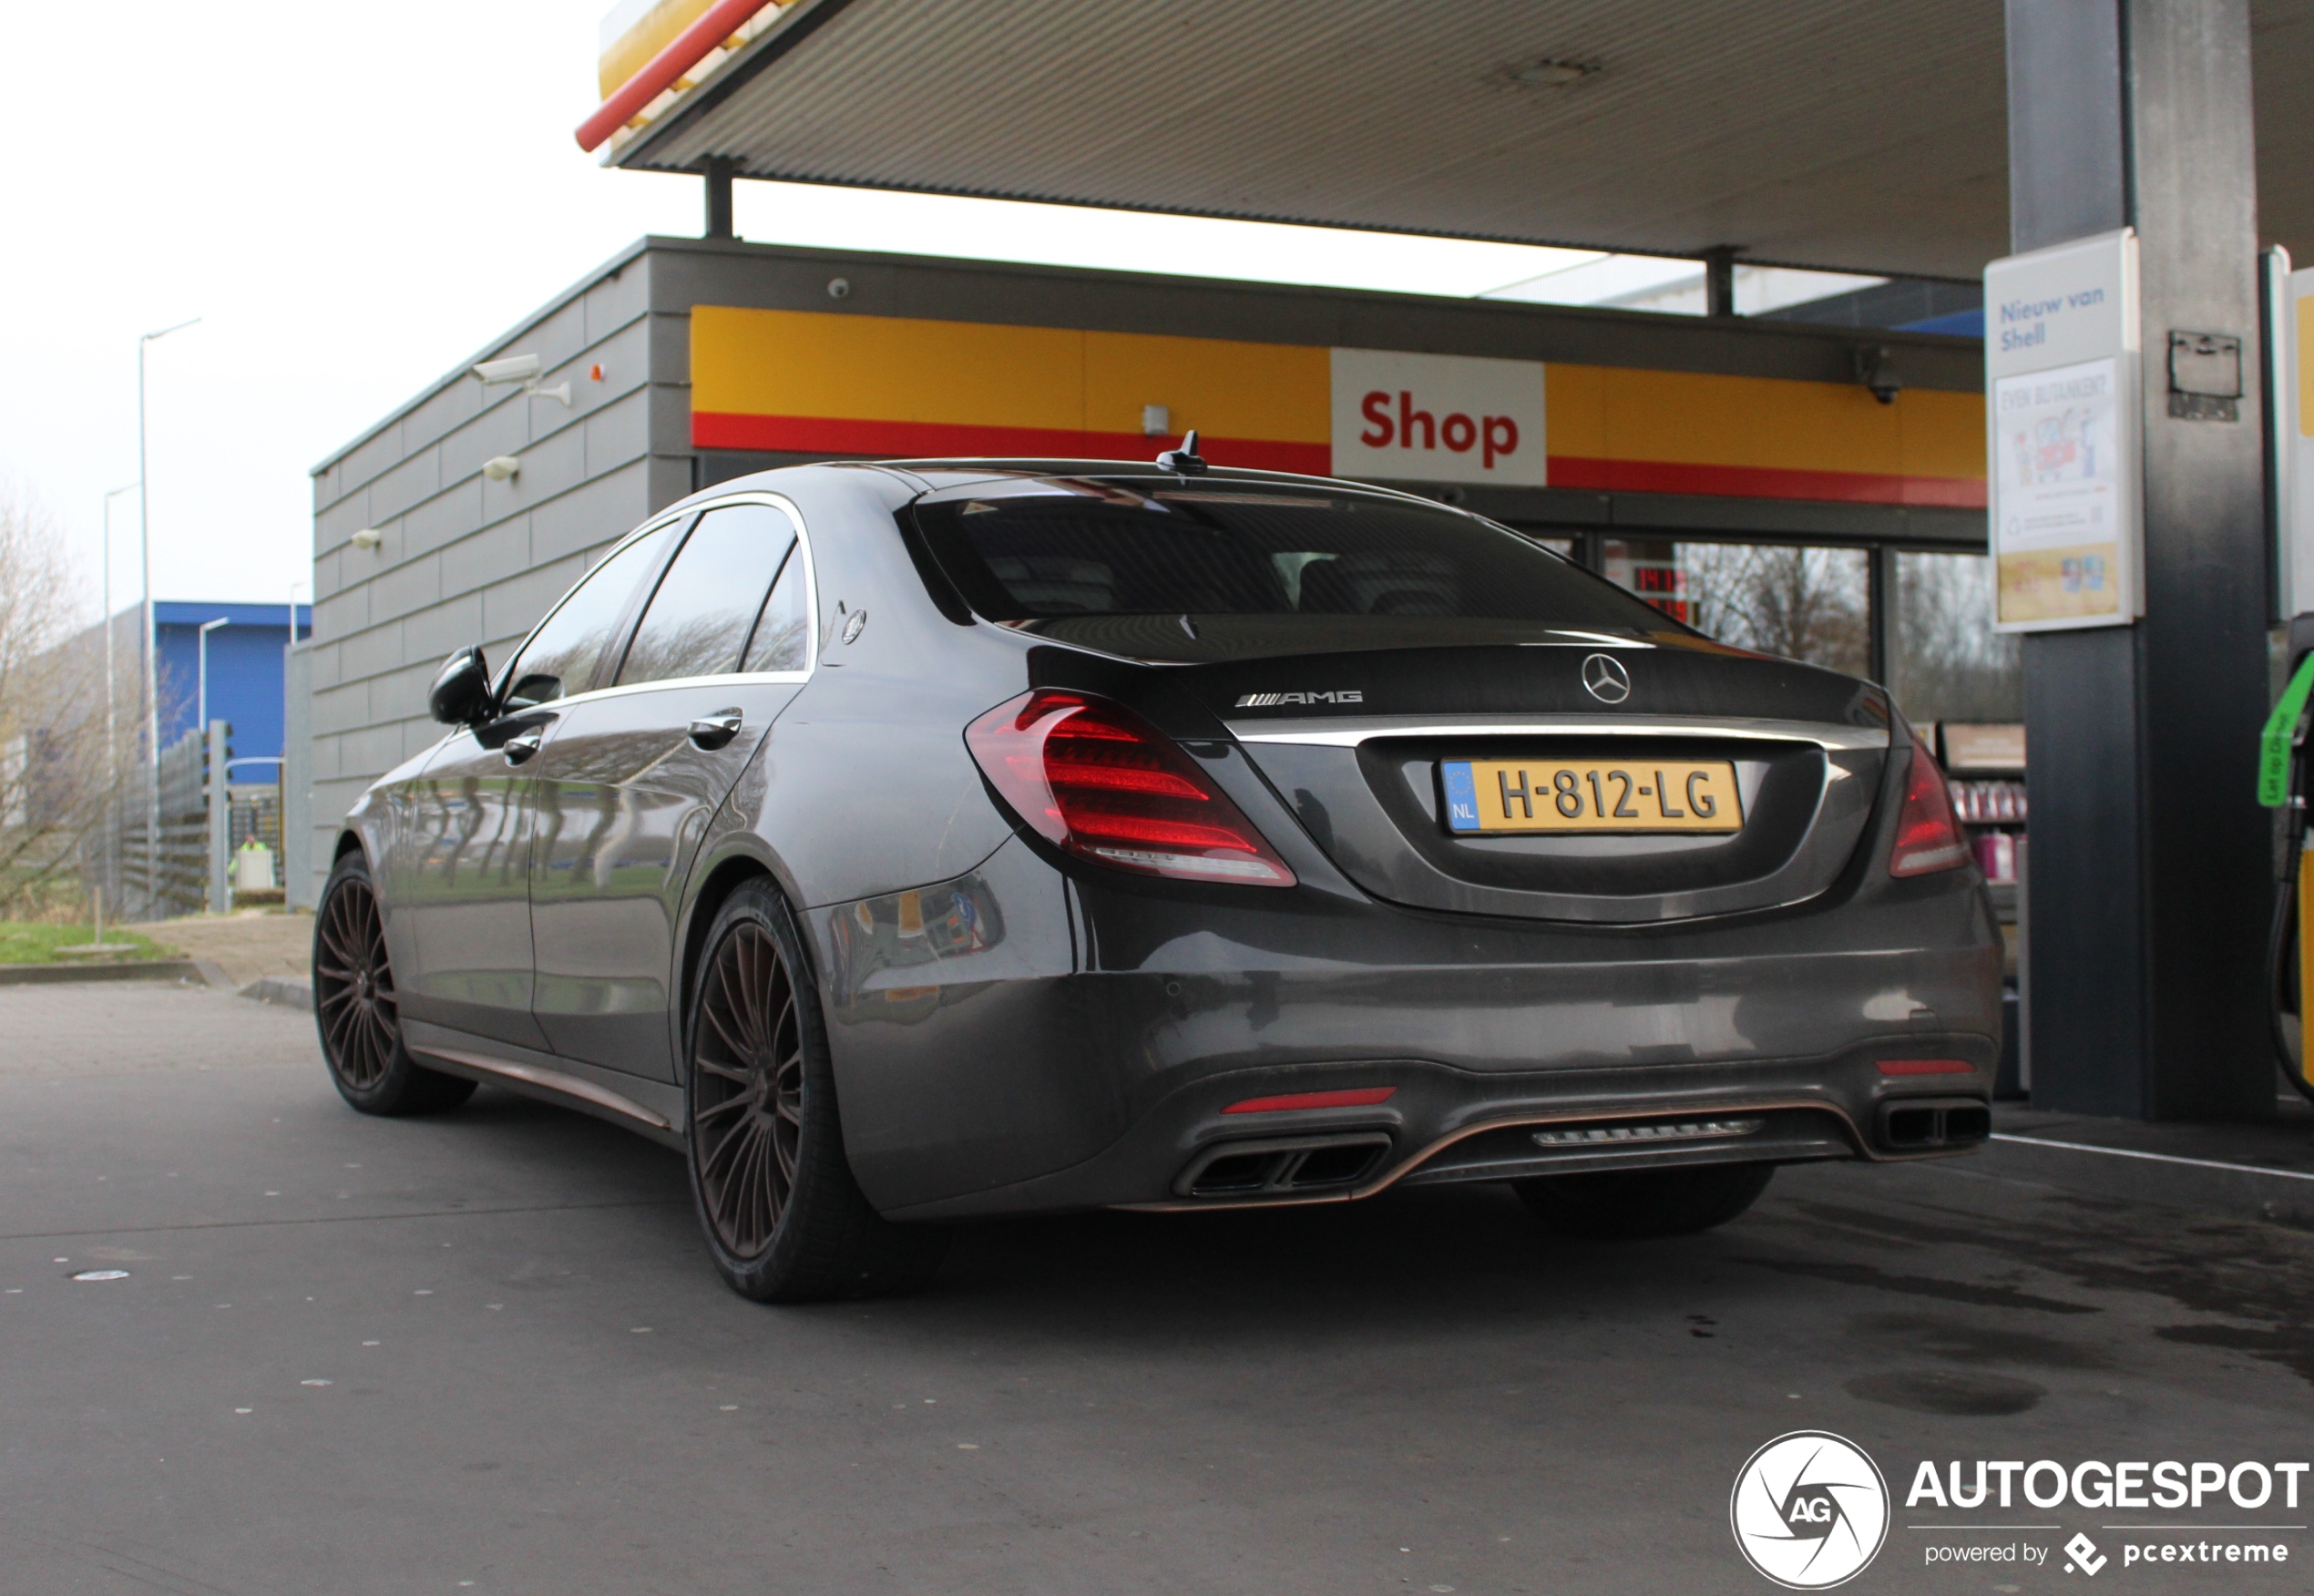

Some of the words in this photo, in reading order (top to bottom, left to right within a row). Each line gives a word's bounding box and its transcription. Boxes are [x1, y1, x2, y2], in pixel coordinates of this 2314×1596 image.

[2001, 298, 2063, 323] Nieuw
[2067, 287, 2104, 308] van
[2002, 322, 2045, 352] Shell
[1360, 390, 1520, 470] Shop
[1275, 690, 1364, 706] AMG
[1498, 769, 1716, 820] H-812-LG
[1452, 803, 1475, 820] NL
